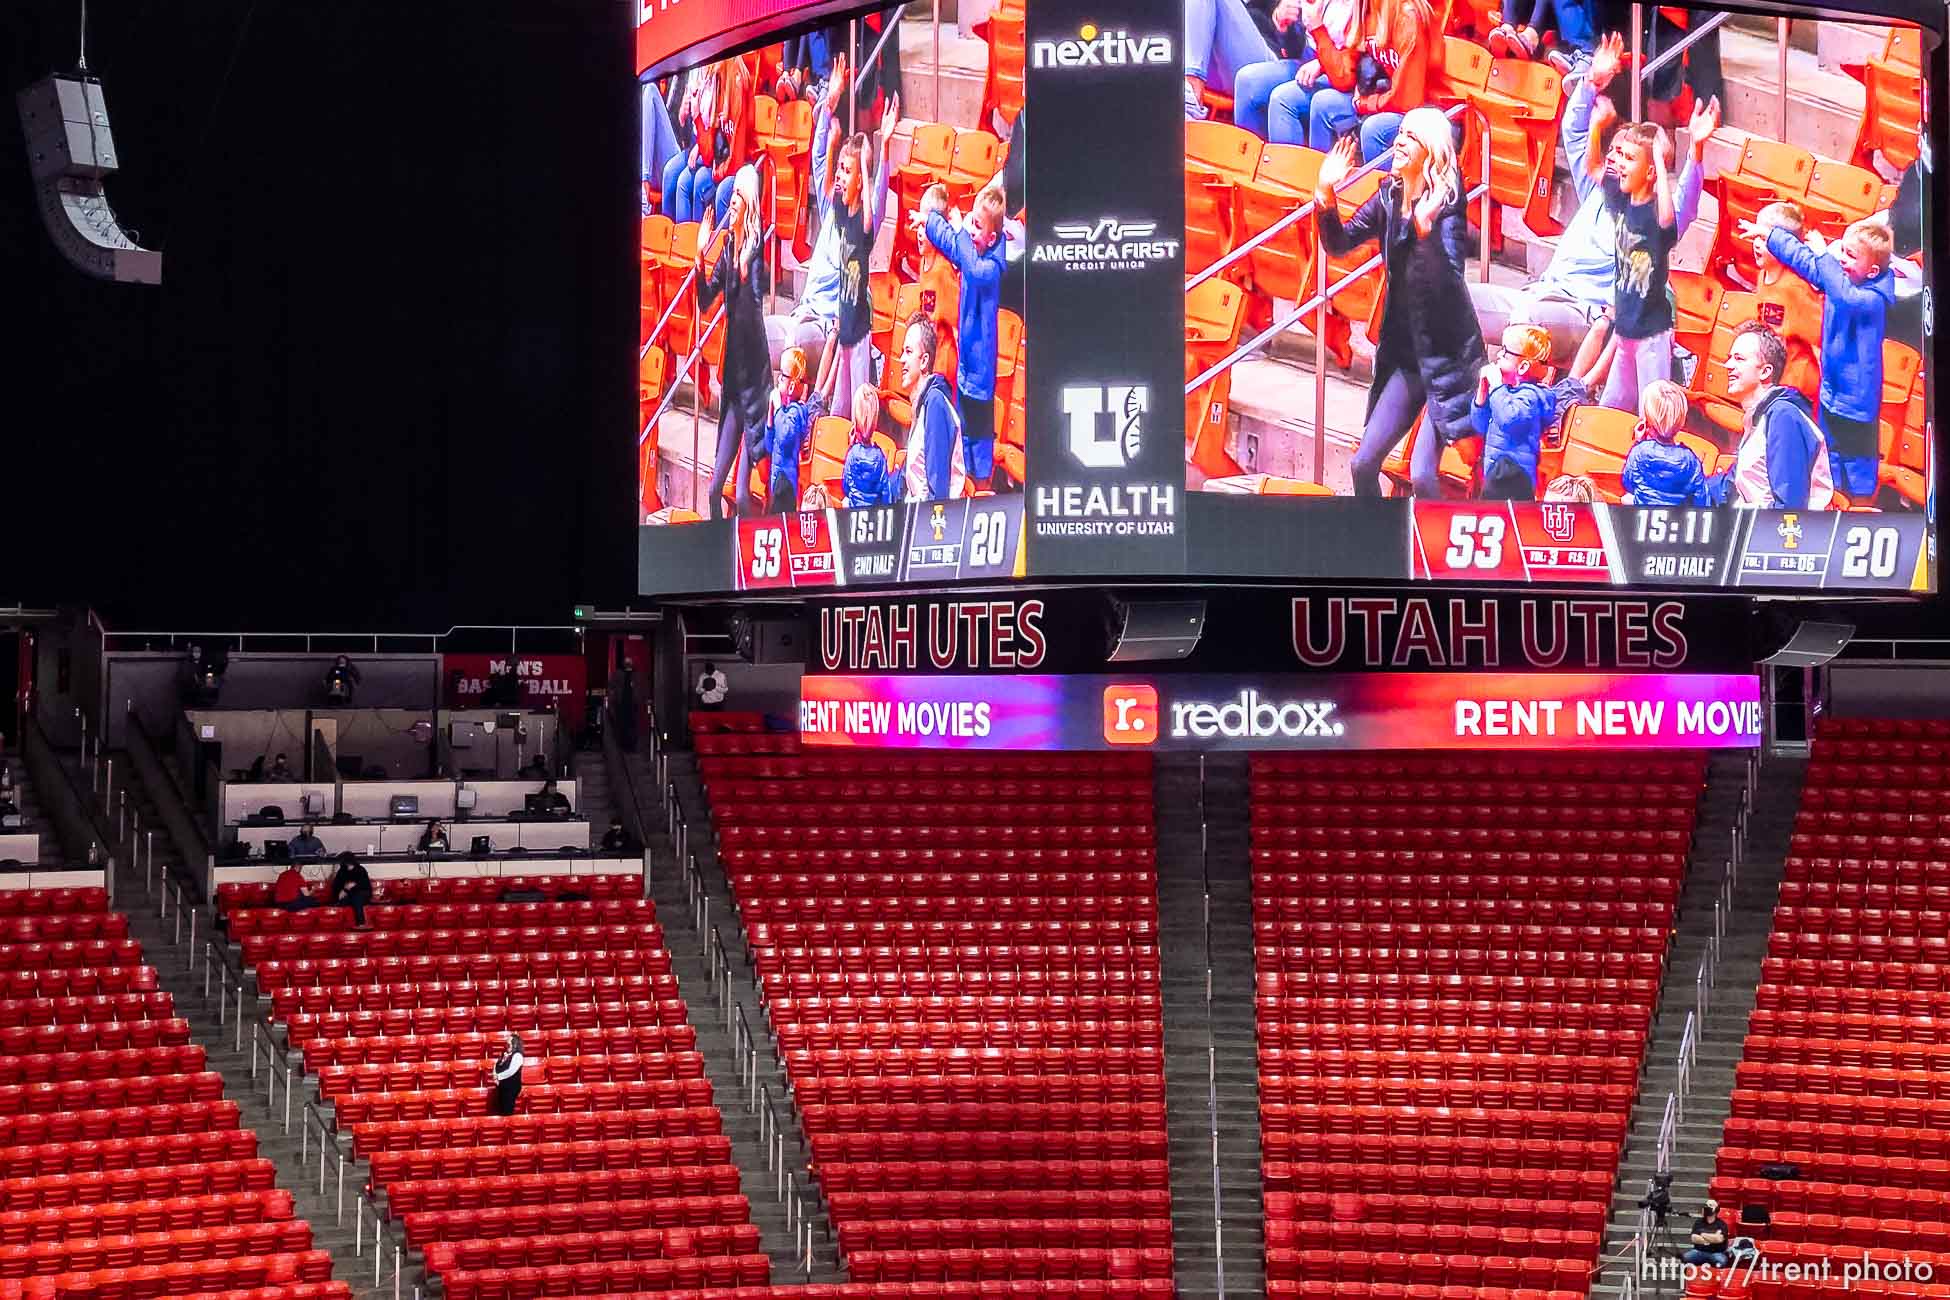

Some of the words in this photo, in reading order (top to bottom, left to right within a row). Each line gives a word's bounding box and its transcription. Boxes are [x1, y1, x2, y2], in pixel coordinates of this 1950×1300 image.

[1033, 30, 1172, 68] nextiva
[1031, 243, 1120, 262] AMERICA
[1121, 241, 1180, 259] FIRST
[1065, 261, 1105, 271] CREDIT
[1110, 260, 1145, 270] UNION
[1036, 485, 1174, 517] HEALTH
[850, 508, 894, 543] 15:11
[969, 511, 1007, 567] 20
[1036, 522, 1114, 535] UNIVERSITY
[1115, 522, 1136, 535] OF
[1137, 521, 1174, 535] UTAH
[1445, 515, 1505, 569] 53
[1635, 509, 1713, 544] 15:11
[752, 528, 782, 578] 53
[854, 556, 872, 576] 2ND
[872, 554, 894, 575] HALF
[1645, 556, 1675, 577] 2ND
[1678, 557, 1714, 577] HALF
[1842, 526, 1899, 578] 20
[821, 604, 917, 670] UTAH
[928, 600, 1047, 669] UTES
[1291, 597, 1499, 667] UTAH
[1520, 600, 1688, 668] UTES
[800, 700, 840, 733] RENT
[844, 701, 892, 734] NEW
[897, 702, 991, 737] MOVIES
[1115, 698, 1145, 731] r.
[1171, 689, 1345, 737] redbox.
[1455, 700, 1563, 736] RENT
[1577, 700, 1664, 735] NEW
[1676, 701, 1763, 736] MOVIE
